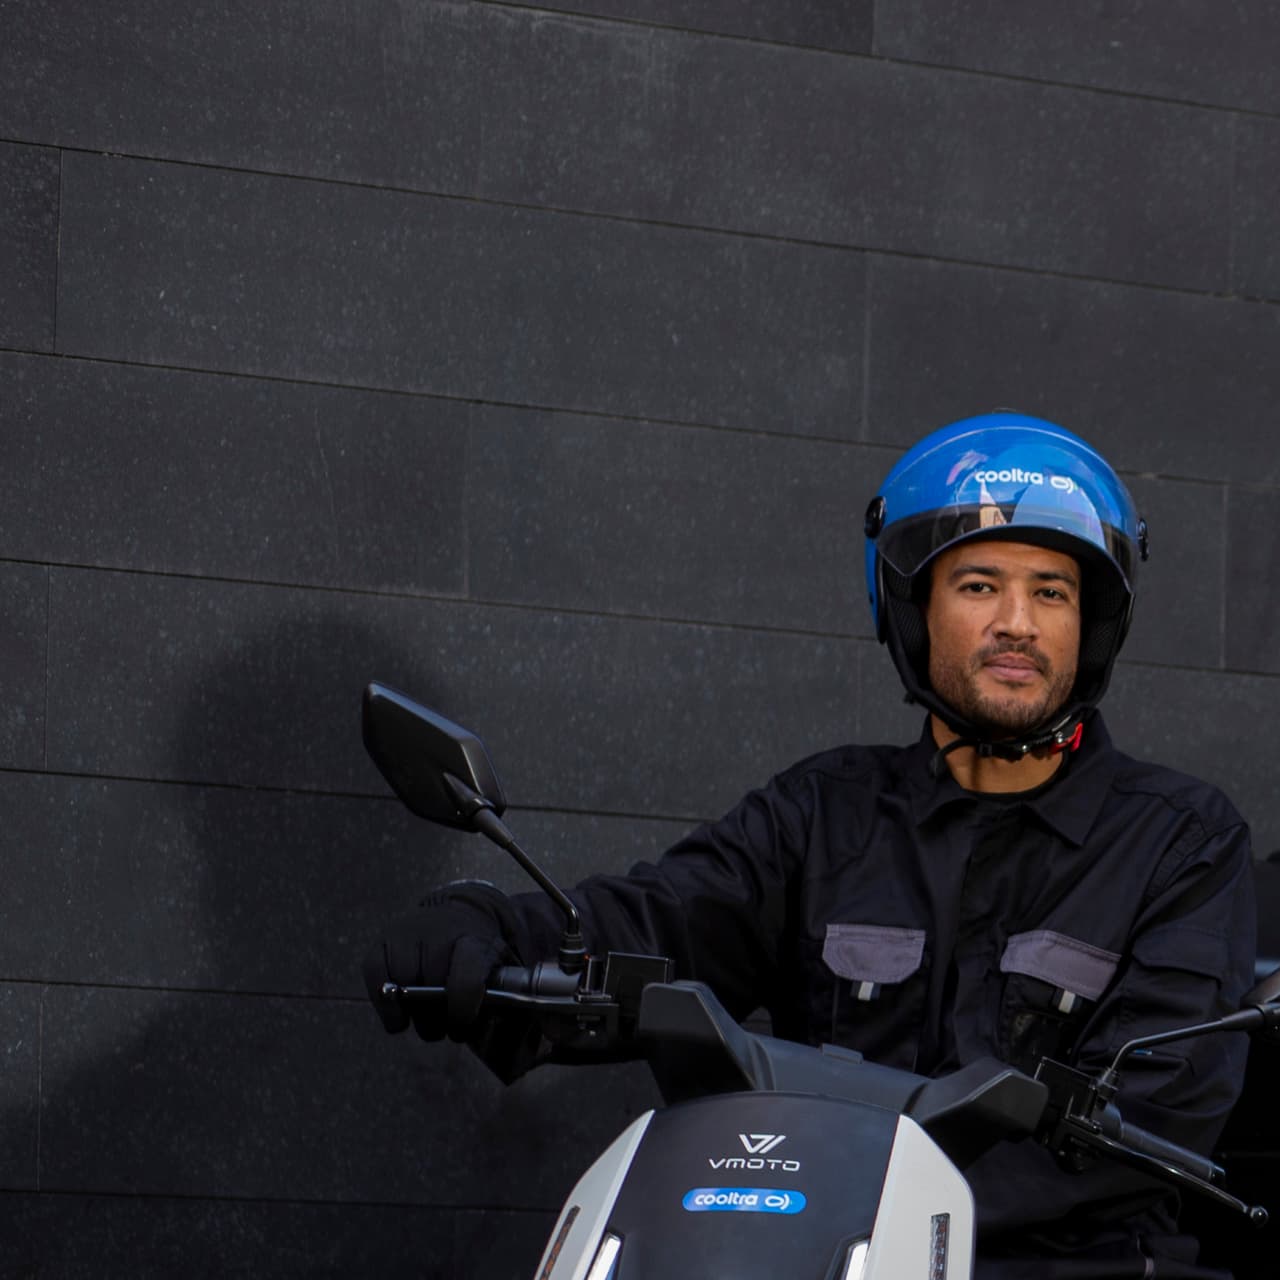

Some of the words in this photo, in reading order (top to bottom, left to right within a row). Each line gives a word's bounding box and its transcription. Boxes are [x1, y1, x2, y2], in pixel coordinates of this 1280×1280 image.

[975, 468, 1044, 485] cooltra
[708, 1158, 801, 1172] VMOTO
[694, 1192, 759, 1206] cooltra
